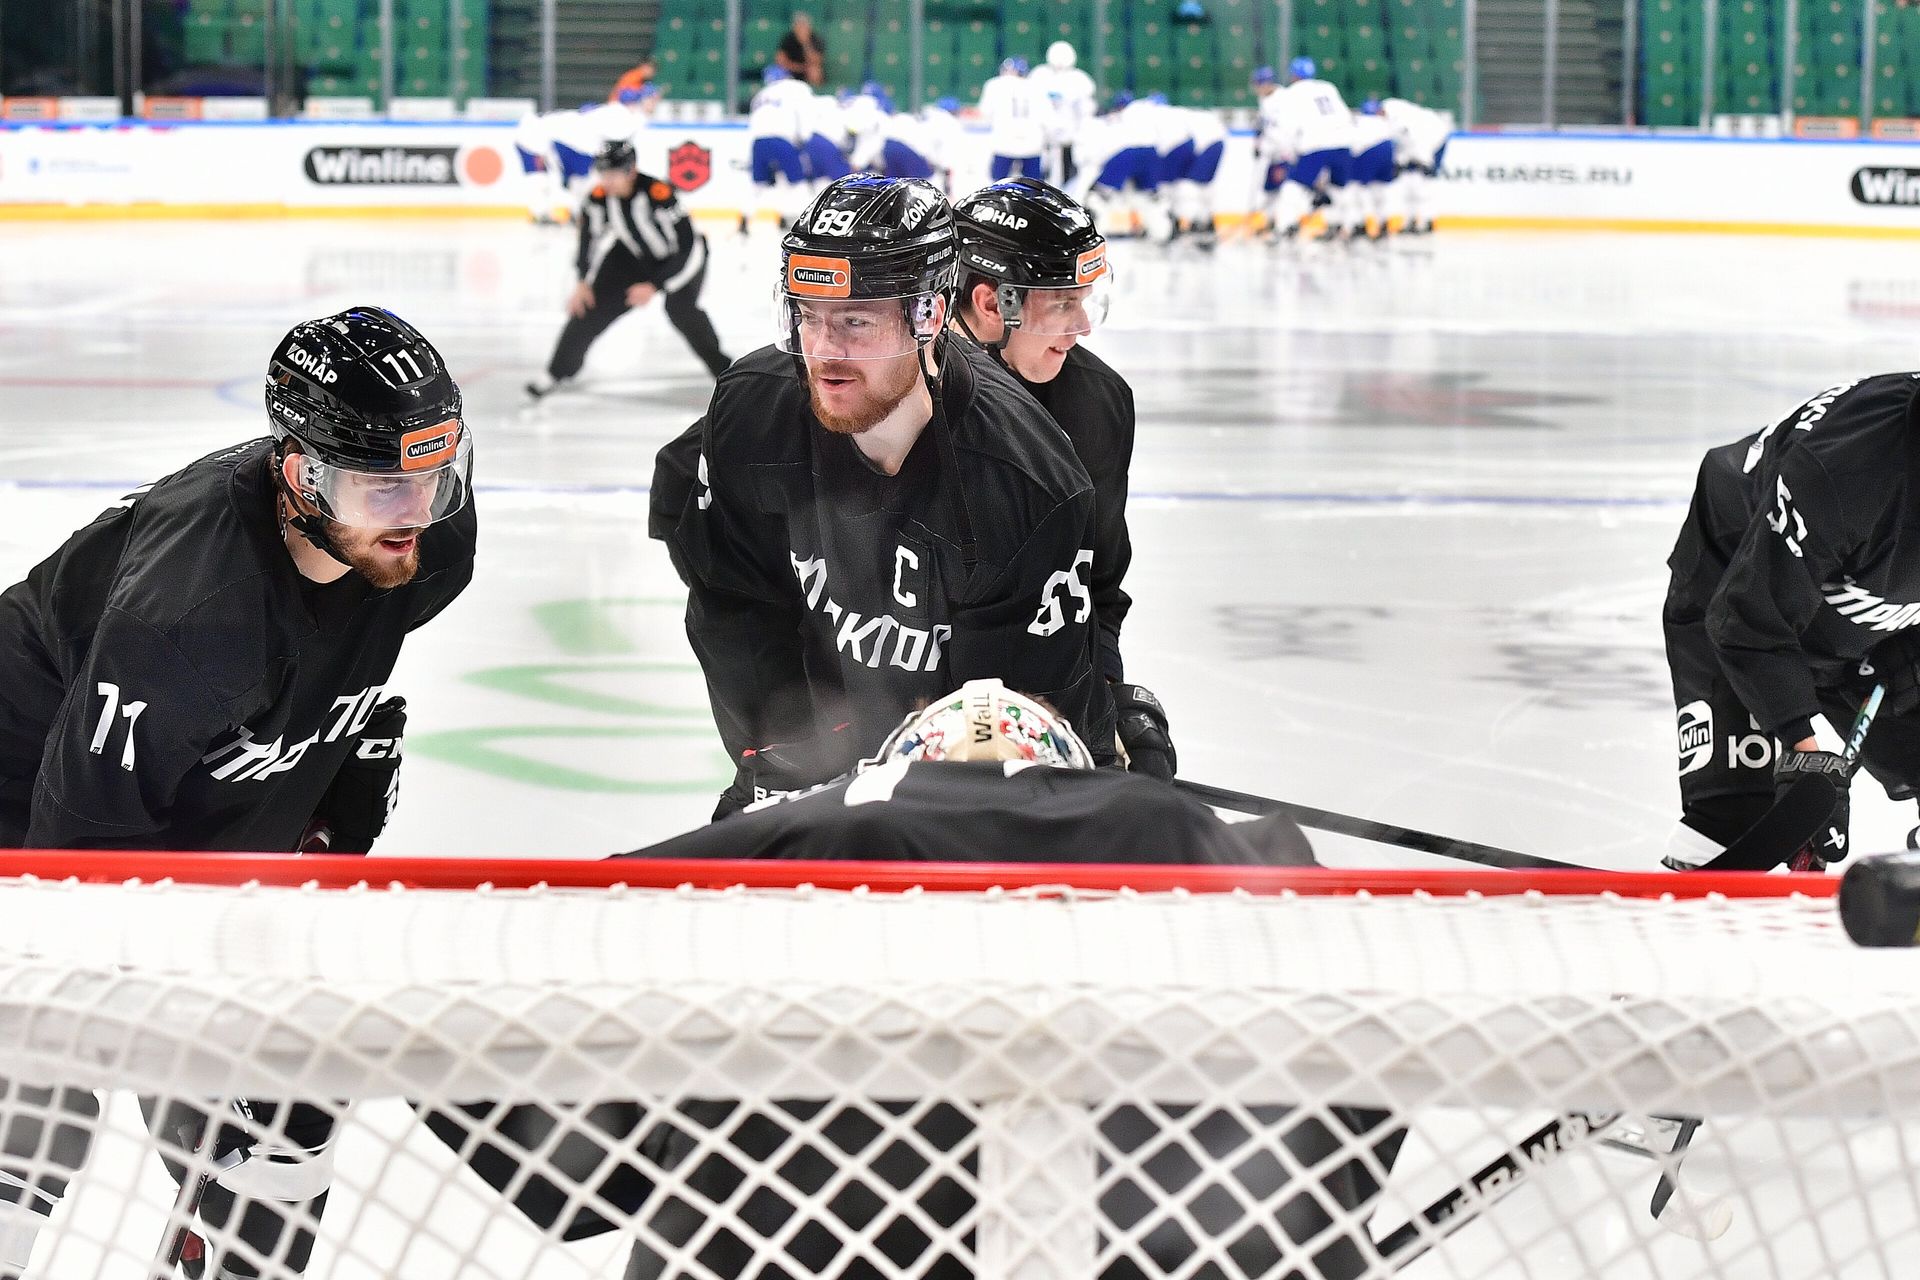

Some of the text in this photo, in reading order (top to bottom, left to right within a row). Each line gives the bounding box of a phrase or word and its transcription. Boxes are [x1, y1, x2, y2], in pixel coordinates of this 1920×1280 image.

[310, 148, 450, 182] Winline
[812, 208, 856, 237] 89
[796, 270, 831, 283] Winline
[970, 254, 1007, 273] CCM
[382, 349, 424, 384] 11
[272, 400, 306, 425] CCM
[410, 440, 444, 456] Winline
[893, 545, 919, 608] C
[89, 682, 148, 772] 11
